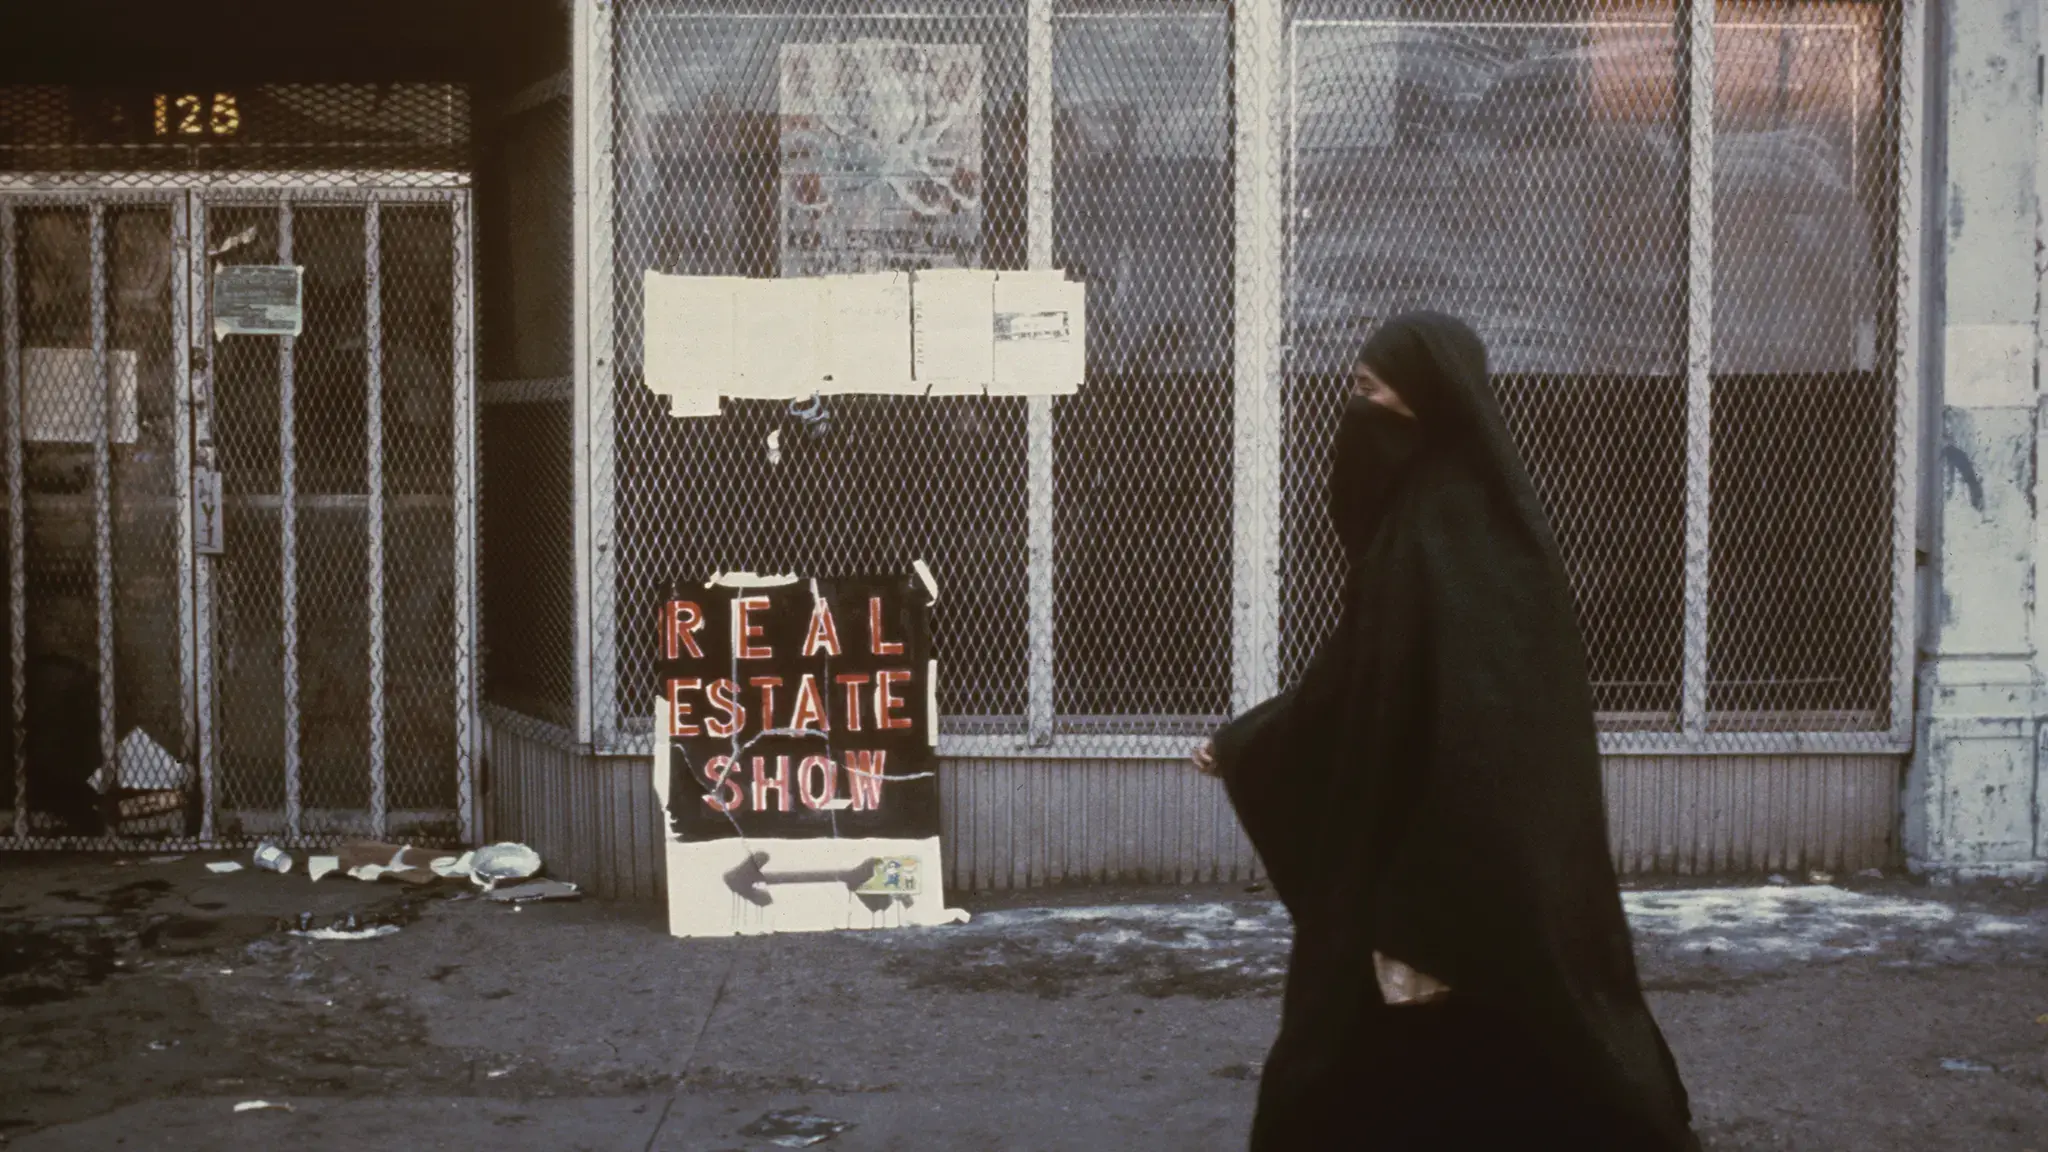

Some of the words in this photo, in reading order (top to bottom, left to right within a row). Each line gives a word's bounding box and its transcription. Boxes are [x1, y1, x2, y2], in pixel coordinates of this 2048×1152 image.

[154, 93, 240, 136] 125
[665, 596, 904, 660] REAL
[667, 670, 912, 737] ESTATE
[703, 750, 886, 812] SHOW
